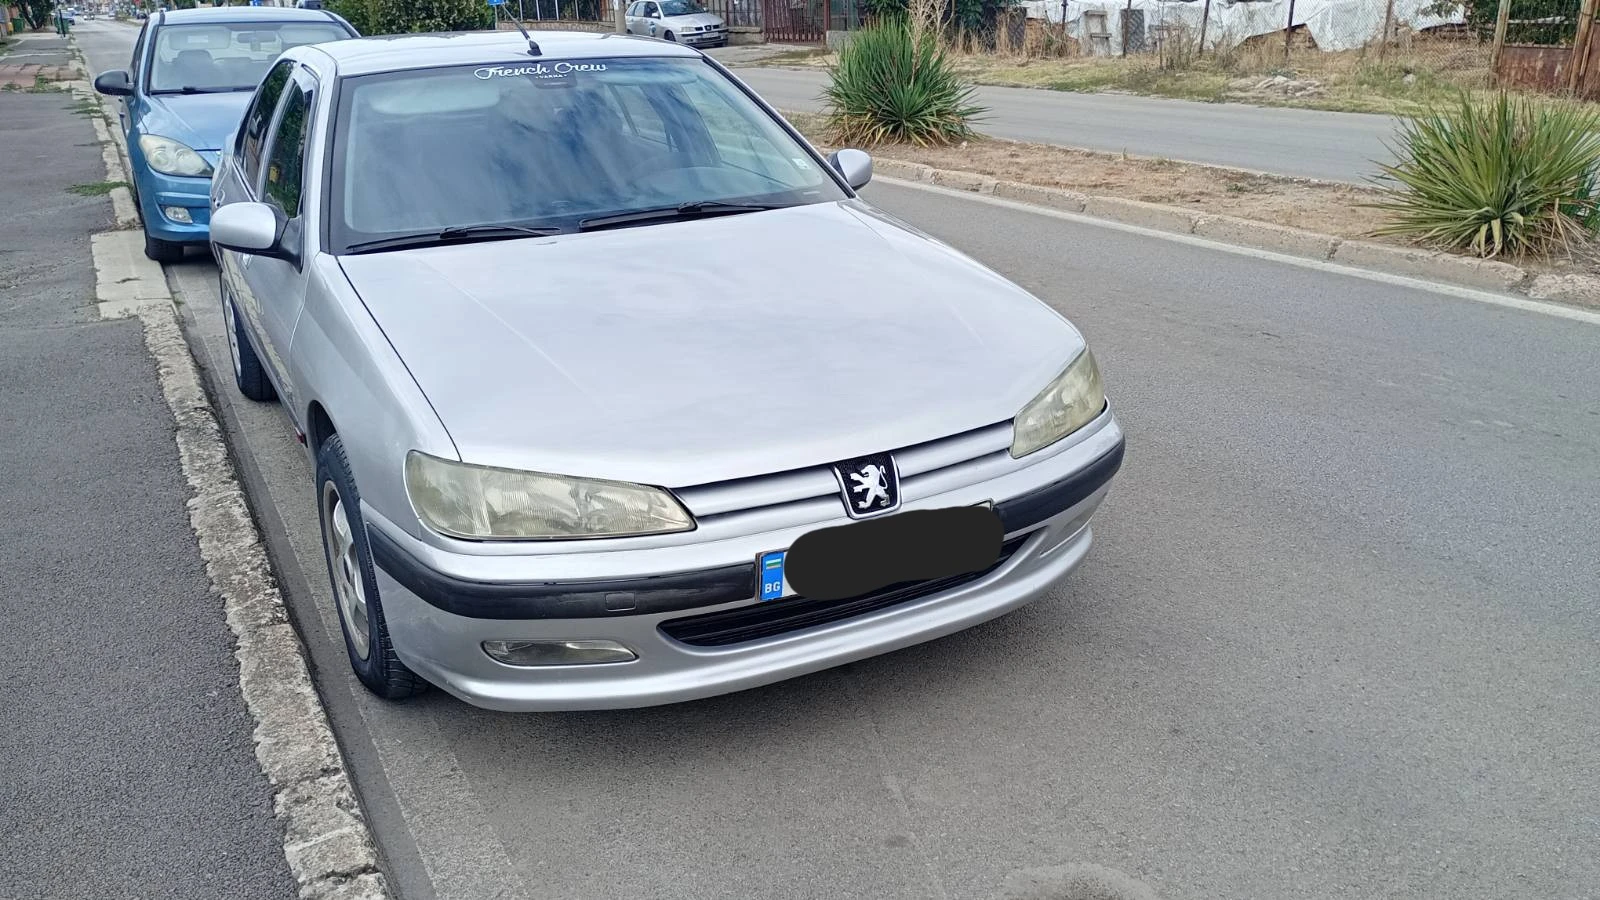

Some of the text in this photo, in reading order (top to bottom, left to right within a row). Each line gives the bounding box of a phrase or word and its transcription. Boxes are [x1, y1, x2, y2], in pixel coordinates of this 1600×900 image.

[473, 62, 608, 80] French Crew
[765, 581, 781, 594] BG
